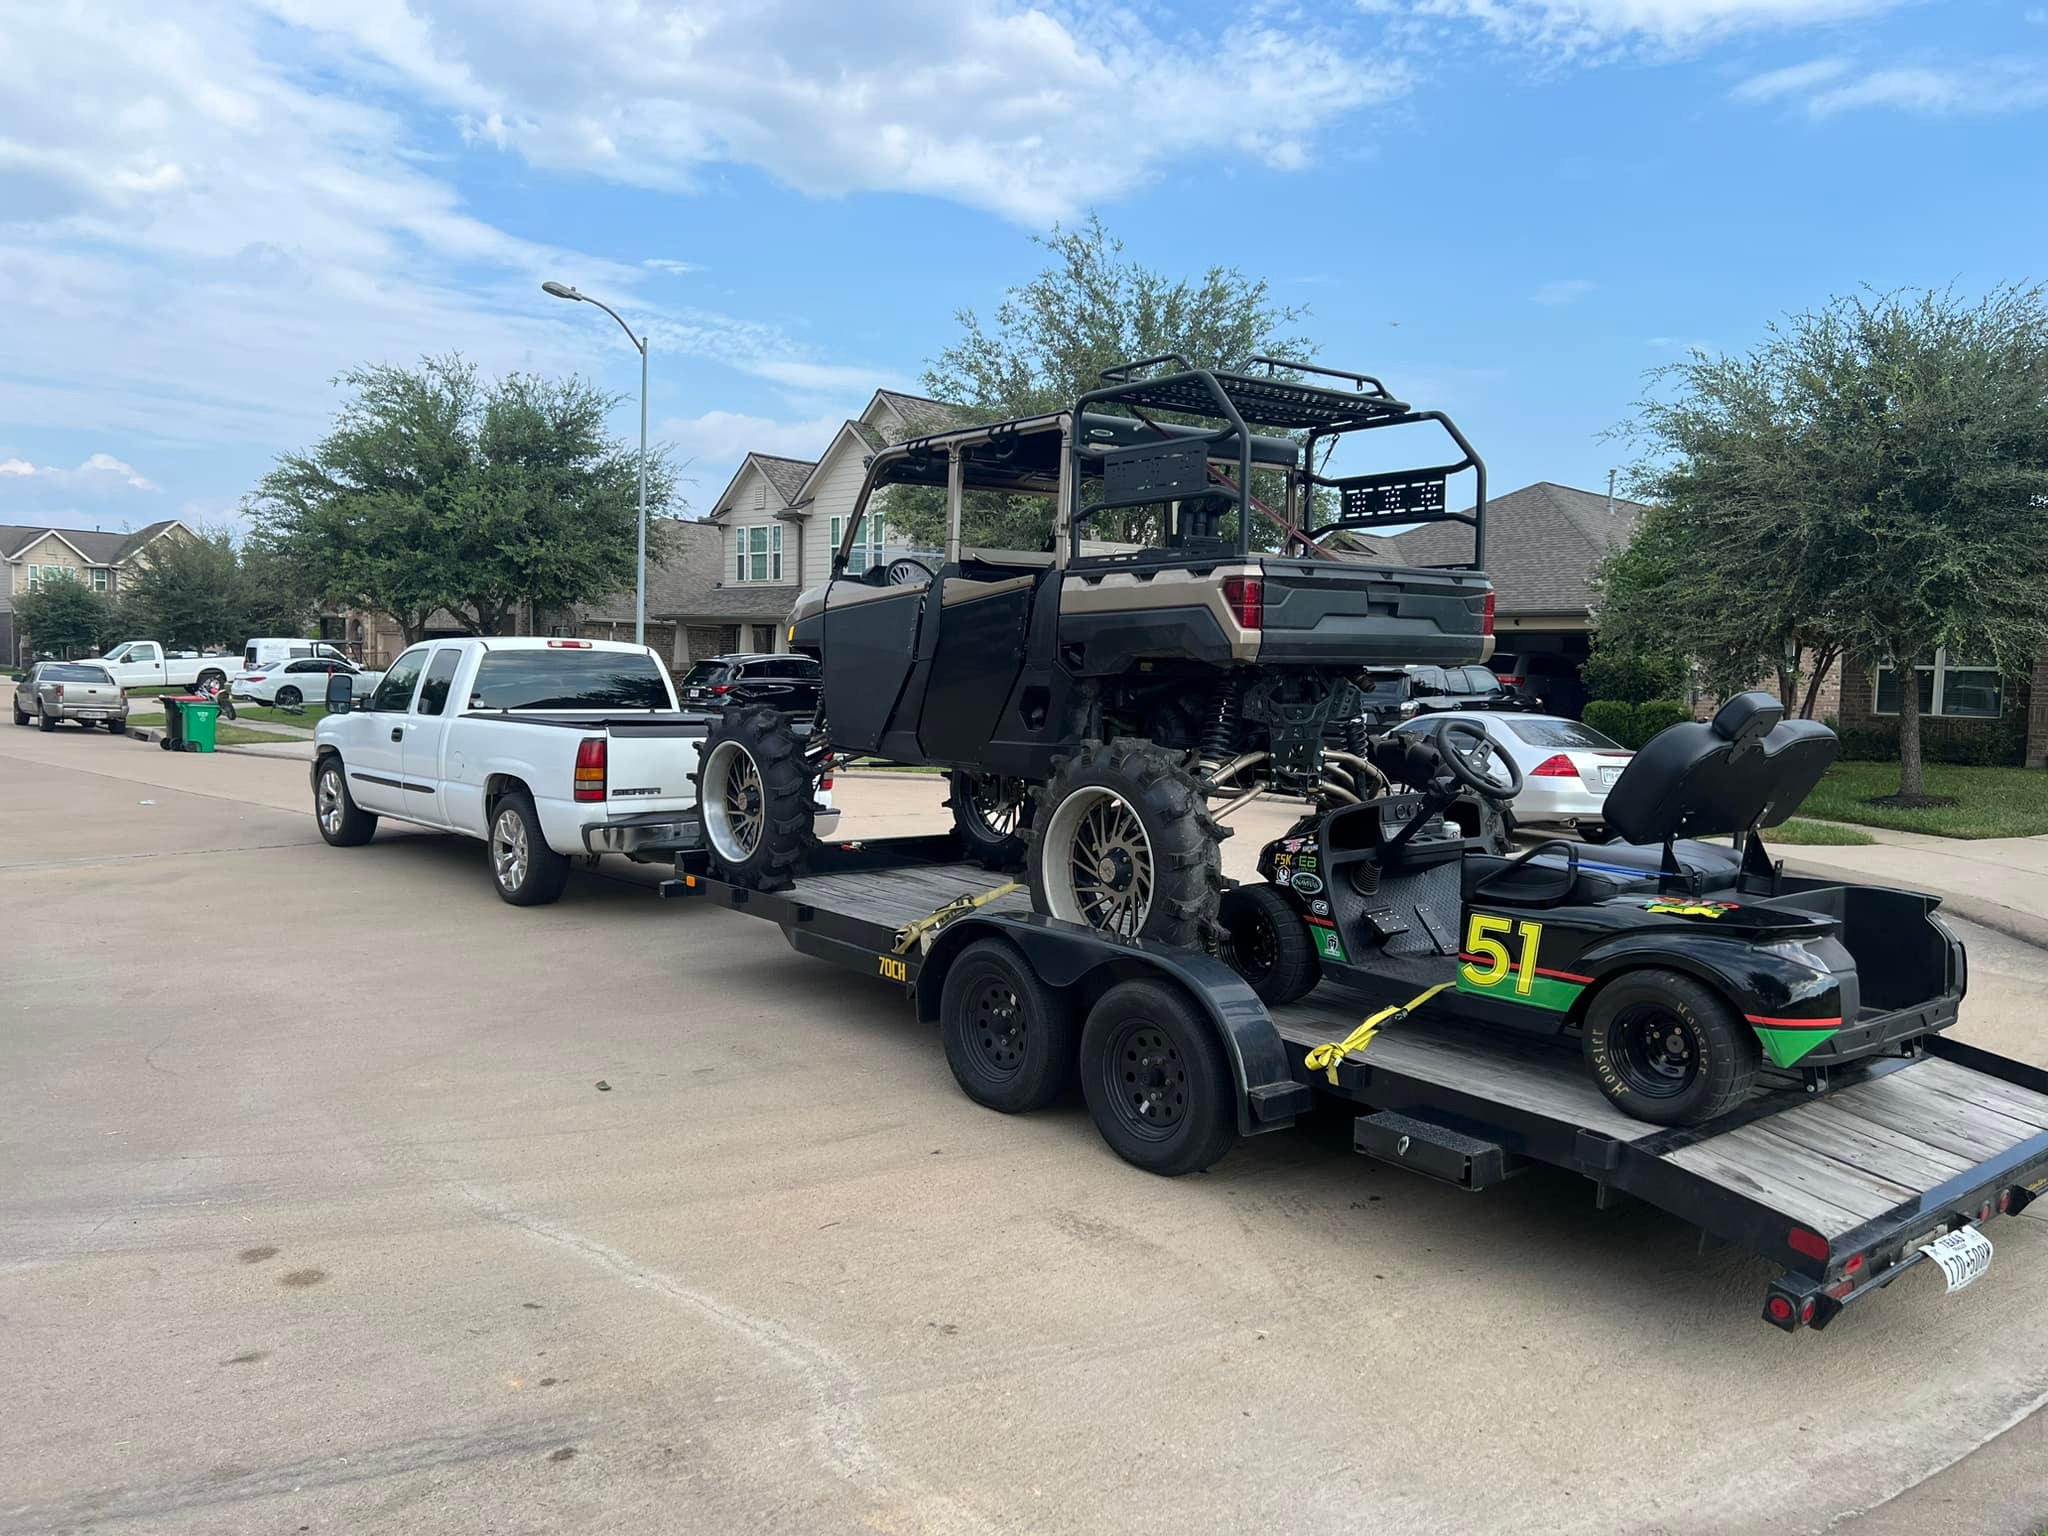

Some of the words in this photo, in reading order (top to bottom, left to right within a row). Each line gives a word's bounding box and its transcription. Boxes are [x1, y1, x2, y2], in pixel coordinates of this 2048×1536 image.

[1274, 853, 1293, 866] FSK
[1461, 913, 1543, 997] 51
[878, 956, 906, 982] 70CH
[1938, 1234, 1966, 1249] TEXAS
